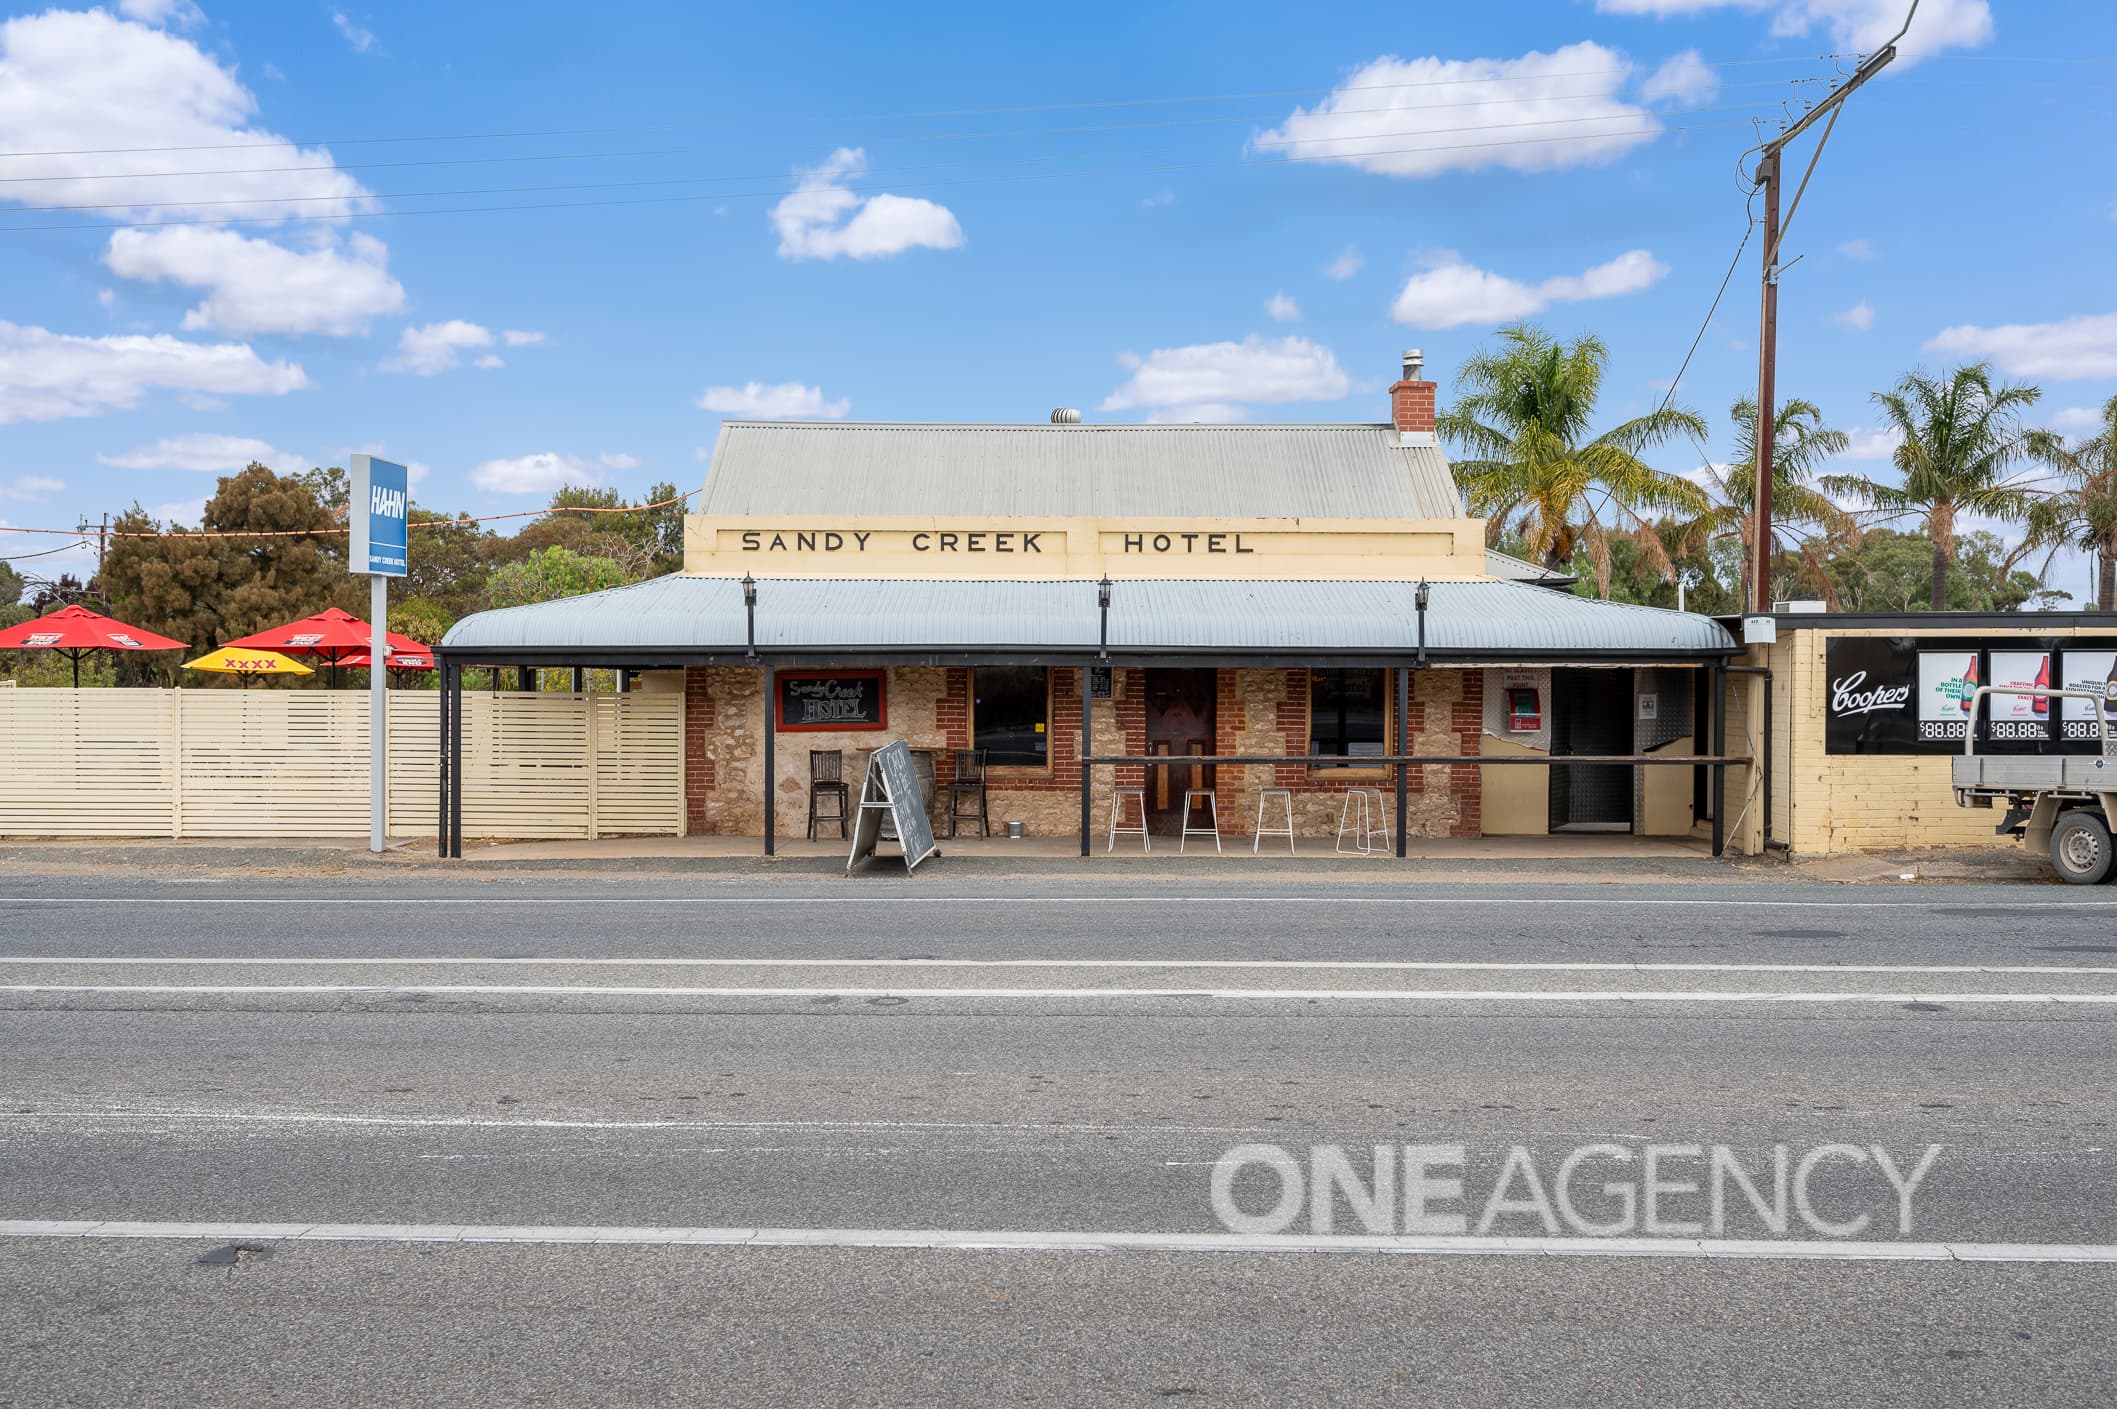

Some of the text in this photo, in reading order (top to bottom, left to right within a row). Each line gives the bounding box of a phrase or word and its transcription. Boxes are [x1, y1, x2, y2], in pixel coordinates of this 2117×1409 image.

[371, 485, 405, 520] HAHN
[742, 532, 1254, 553] SANDY CREEK HOTEL
[369, 555, 406, 567] SANDY CREEK HOTEL
[224, 658, 277, 669] XXXX
[790, 680, 863, 699] Sandy Creek
[1832, 671, 1910, 717] Coopers
[802, 698, 867, 720] HOTEL
[2062, 722, 2102, 738] $88.8
